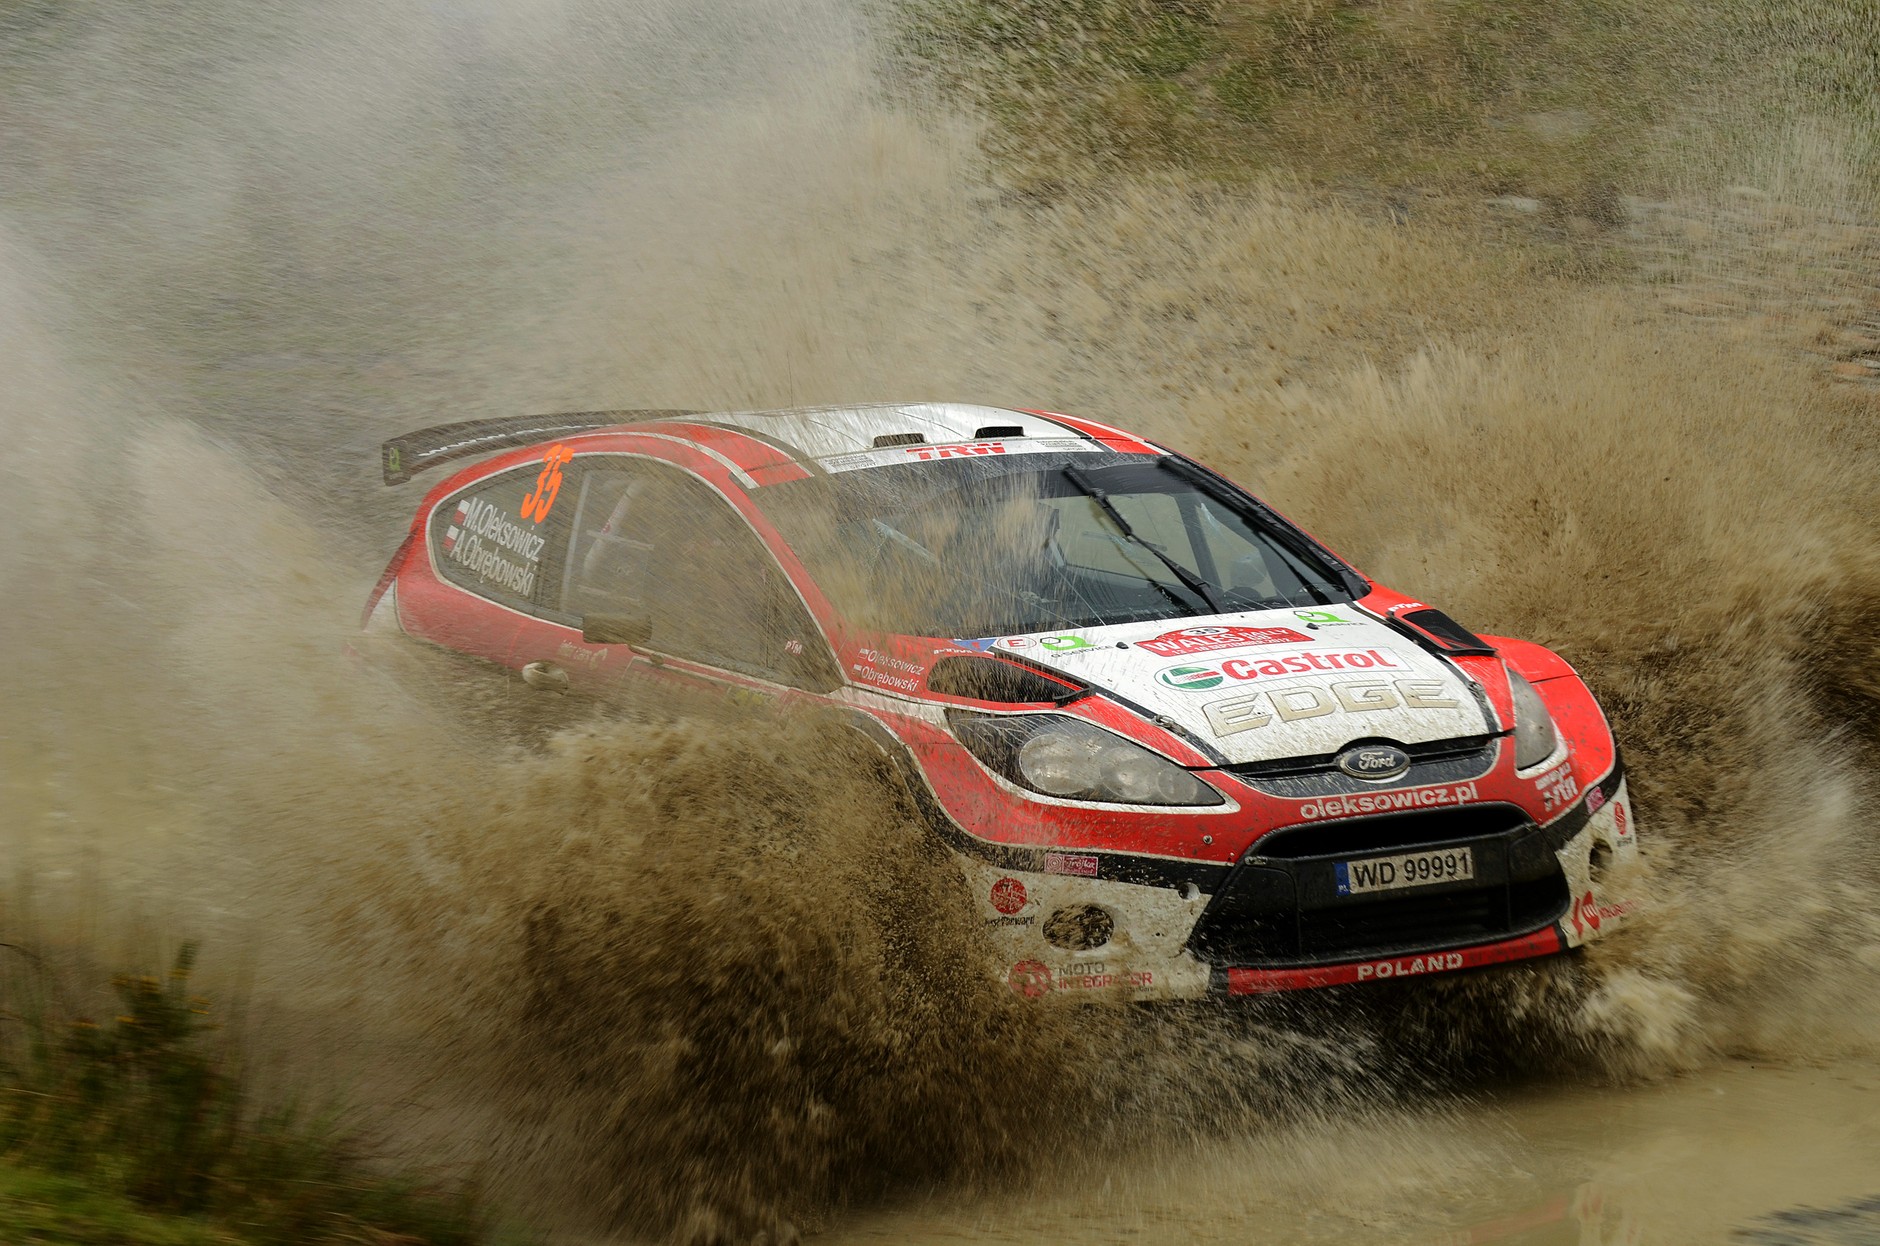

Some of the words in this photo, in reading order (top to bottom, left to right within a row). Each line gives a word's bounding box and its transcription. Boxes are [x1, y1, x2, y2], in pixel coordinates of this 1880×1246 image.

[906, 442, 1006, 460] TRW
[520, 444, 576, 524] 35
[1144, 633, 1246, 651] WALES
[1238, 628, 1292, 639] RALLY
[861, 665, 919, 692] Obrębowski
[1221, 649, 1397, 681] Castrol
[1201, 678, 1460, 738] EDGE
[1358, 751, 1396, 769] Ford
[1300, 781, 1479, 820] oleksowicz.pl
[1353, 861, 1396, 888] WD
[1403, 852, 1471, 882] 99991
[1058, 961, 1105, 976] MOTO
[1357, 952, 1464, 981] POLAND
